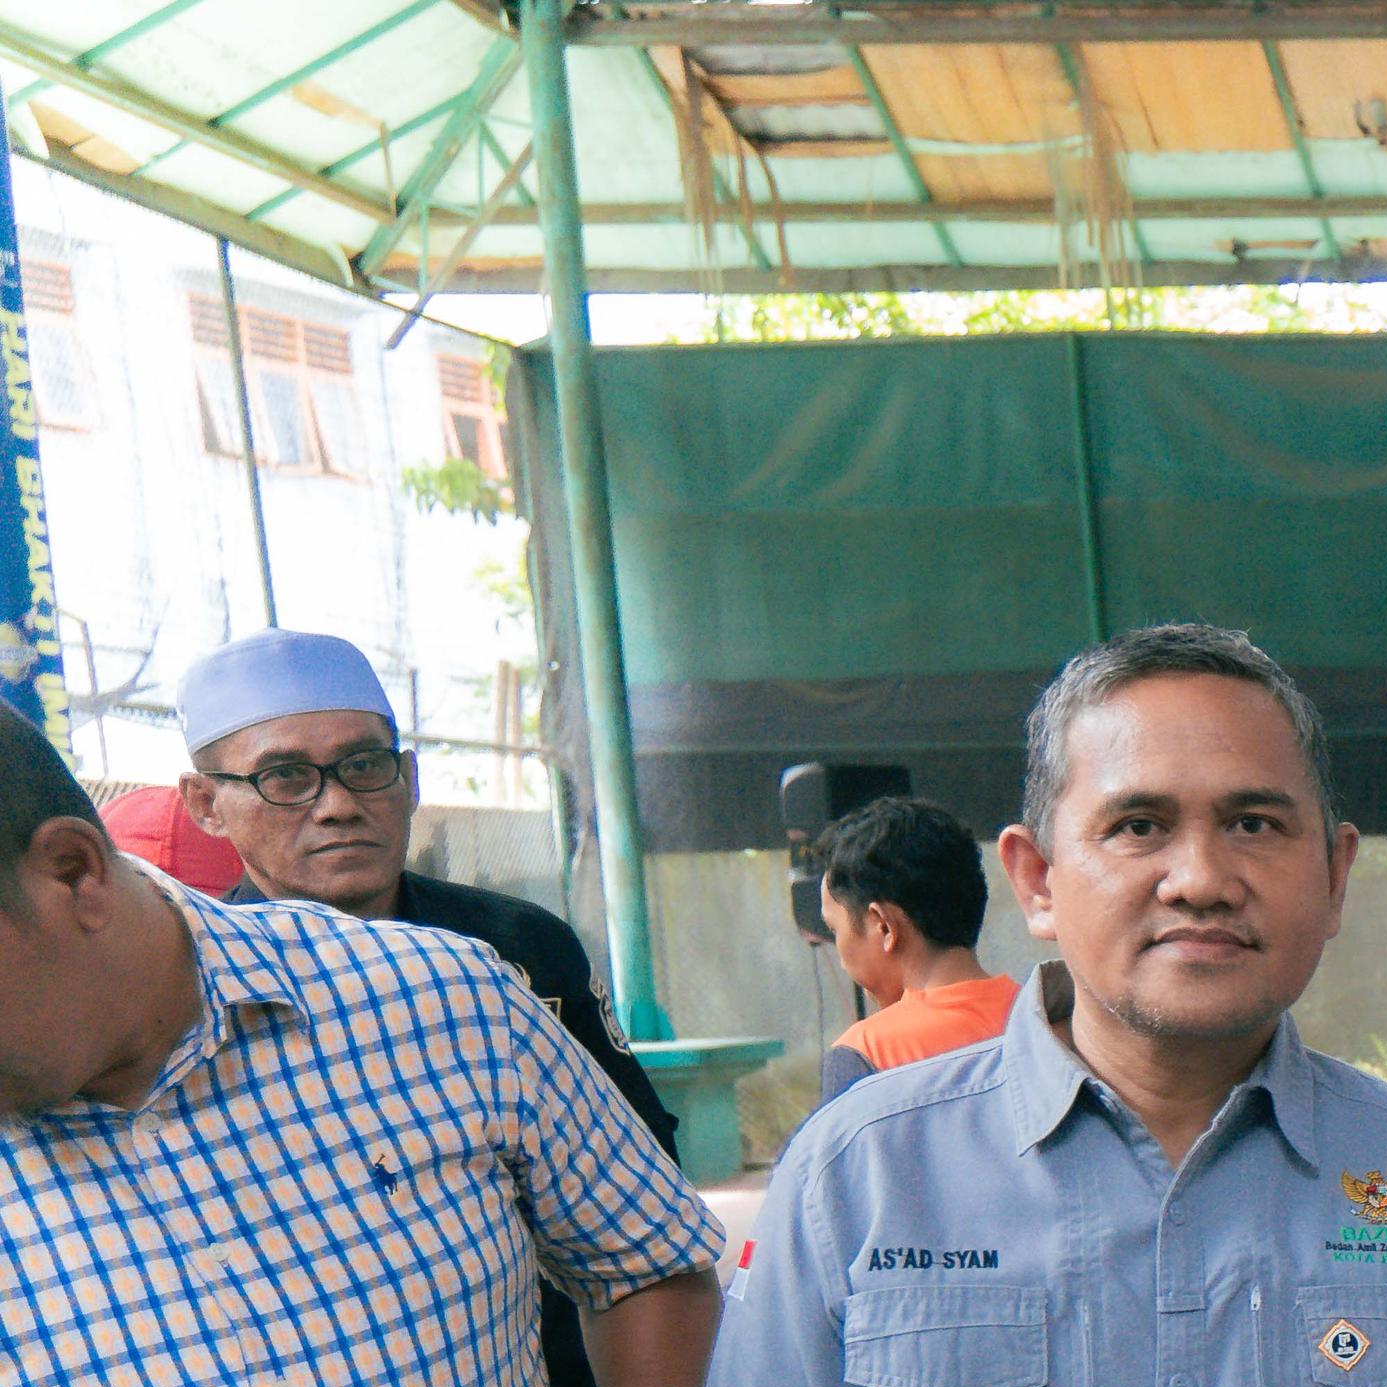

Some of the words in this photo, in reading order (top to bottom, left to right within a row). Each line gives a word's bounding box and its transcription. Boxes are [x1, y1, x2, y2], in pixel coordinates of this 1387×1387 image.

[867, 1247, 933, 1272] AS'AD
[942, 1249, 1000, 1270] SYAM
[1332, 1252, 1376, 1263] KOTA
